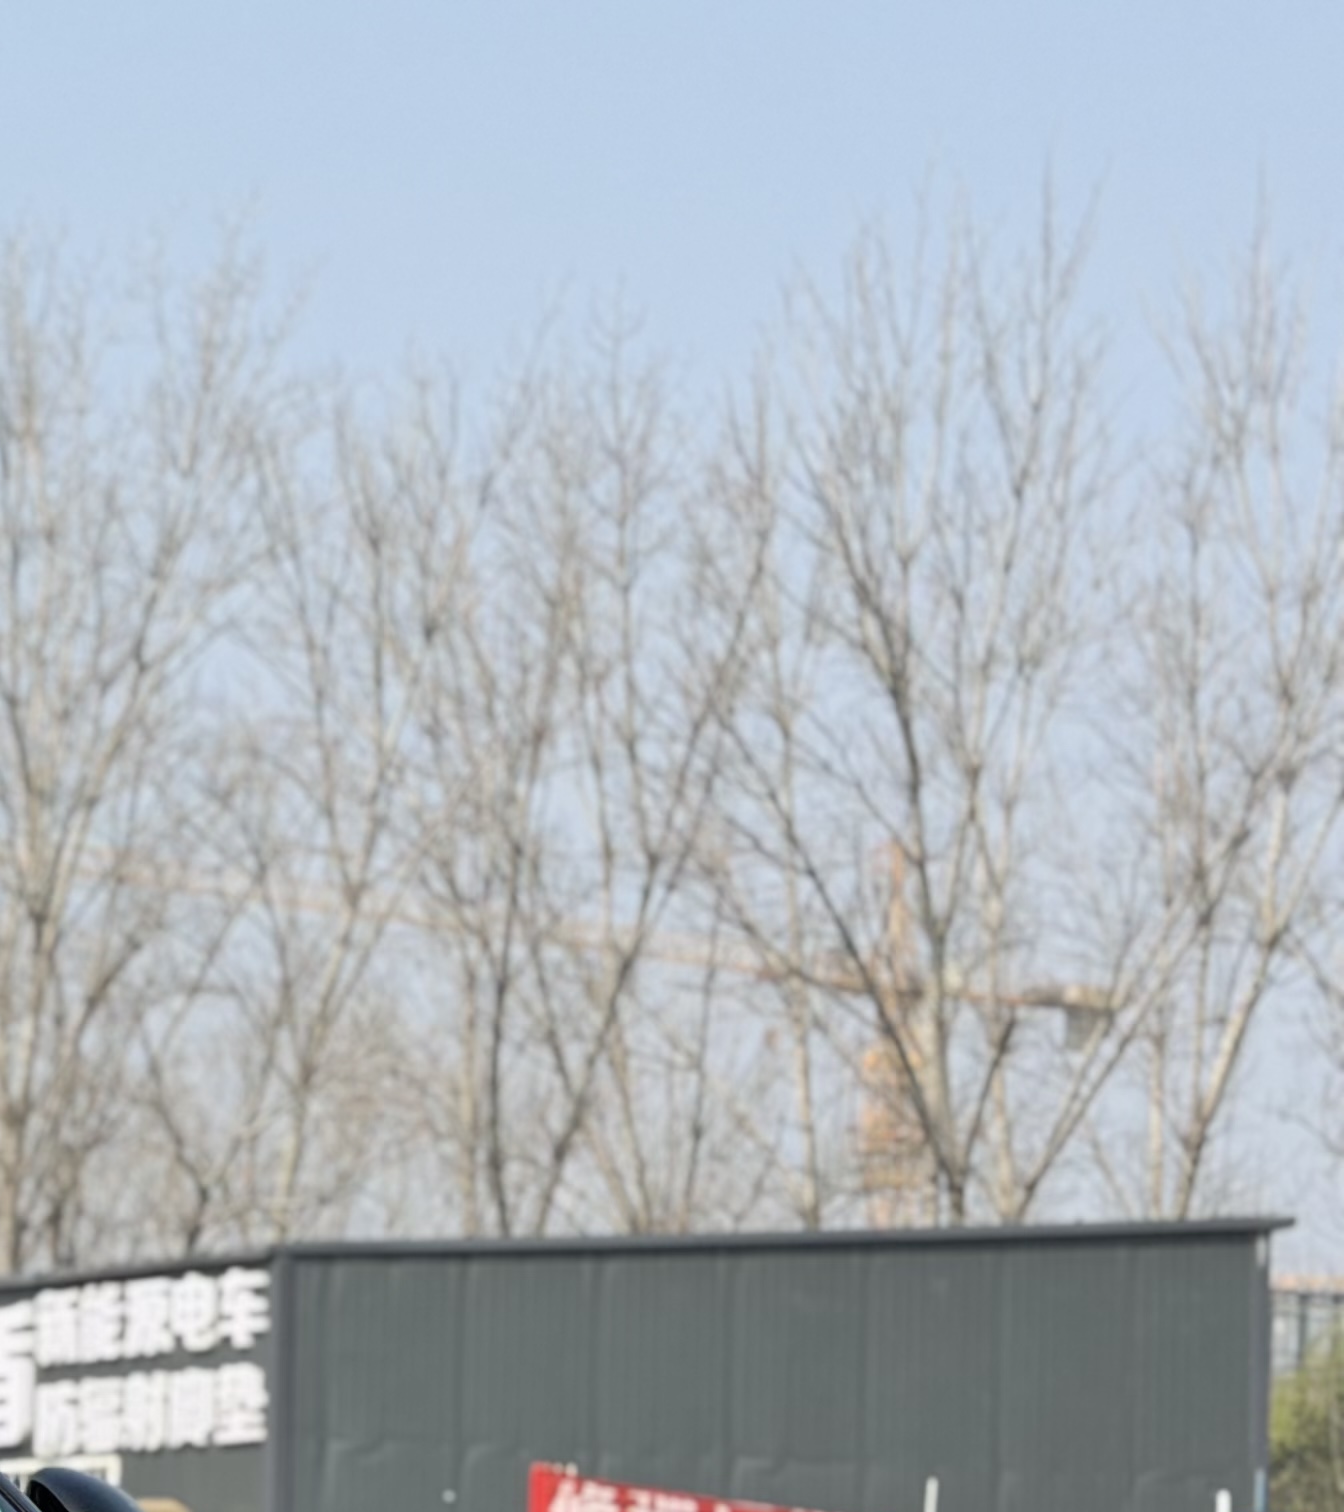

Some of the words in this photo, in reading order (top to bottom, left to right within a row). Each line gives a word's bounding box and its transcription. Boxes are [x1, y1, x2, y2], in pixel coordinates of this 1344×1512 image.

[33, 1266, 272, 1368] 新能源电车
